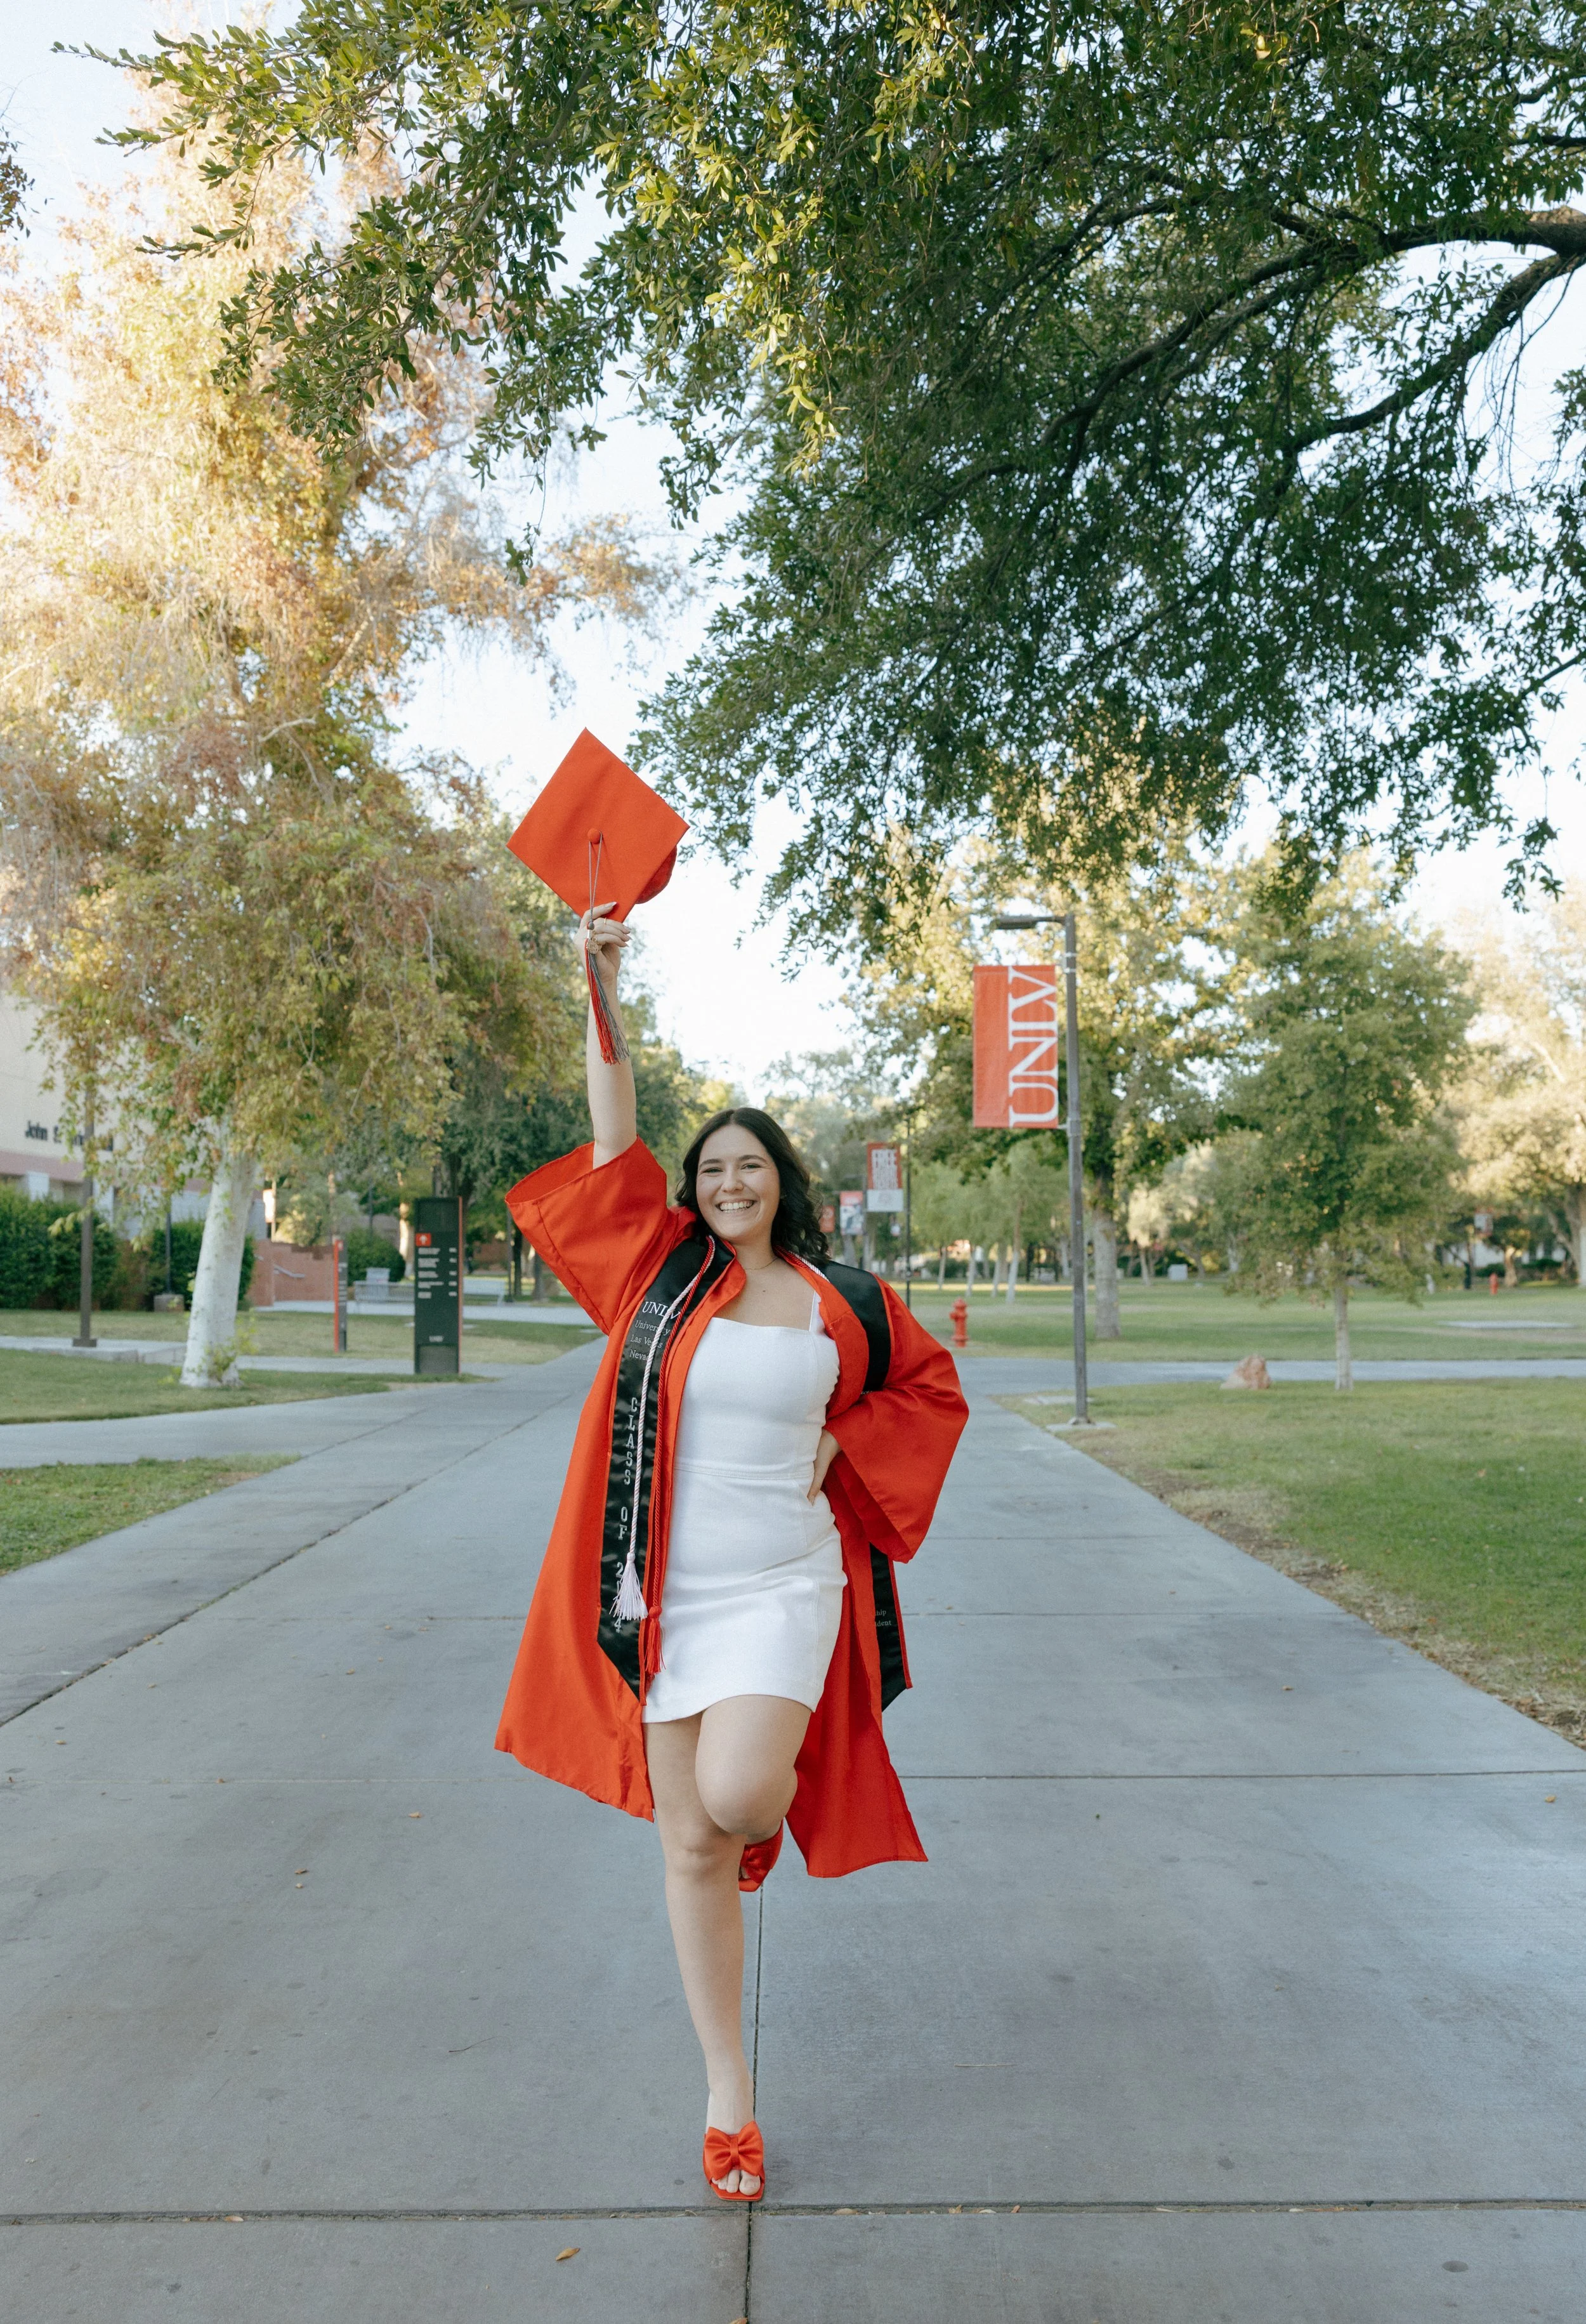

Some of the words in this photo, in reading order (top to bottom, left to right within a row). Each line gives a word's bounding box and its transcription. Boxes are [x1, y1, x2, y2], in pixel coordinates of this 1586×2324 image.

[1008, 966, 1058, 1129] UNLV
[634, 1320, 671, 1336] Univery
[630, 1334, 642, 1343] Las
[644, 1336, 663, 1348] Ves
[629, 1349, 649, 1360] Neva
[624, 1397, 638, 1485] CLASS
[618, 1506, 628, 1540] OF
